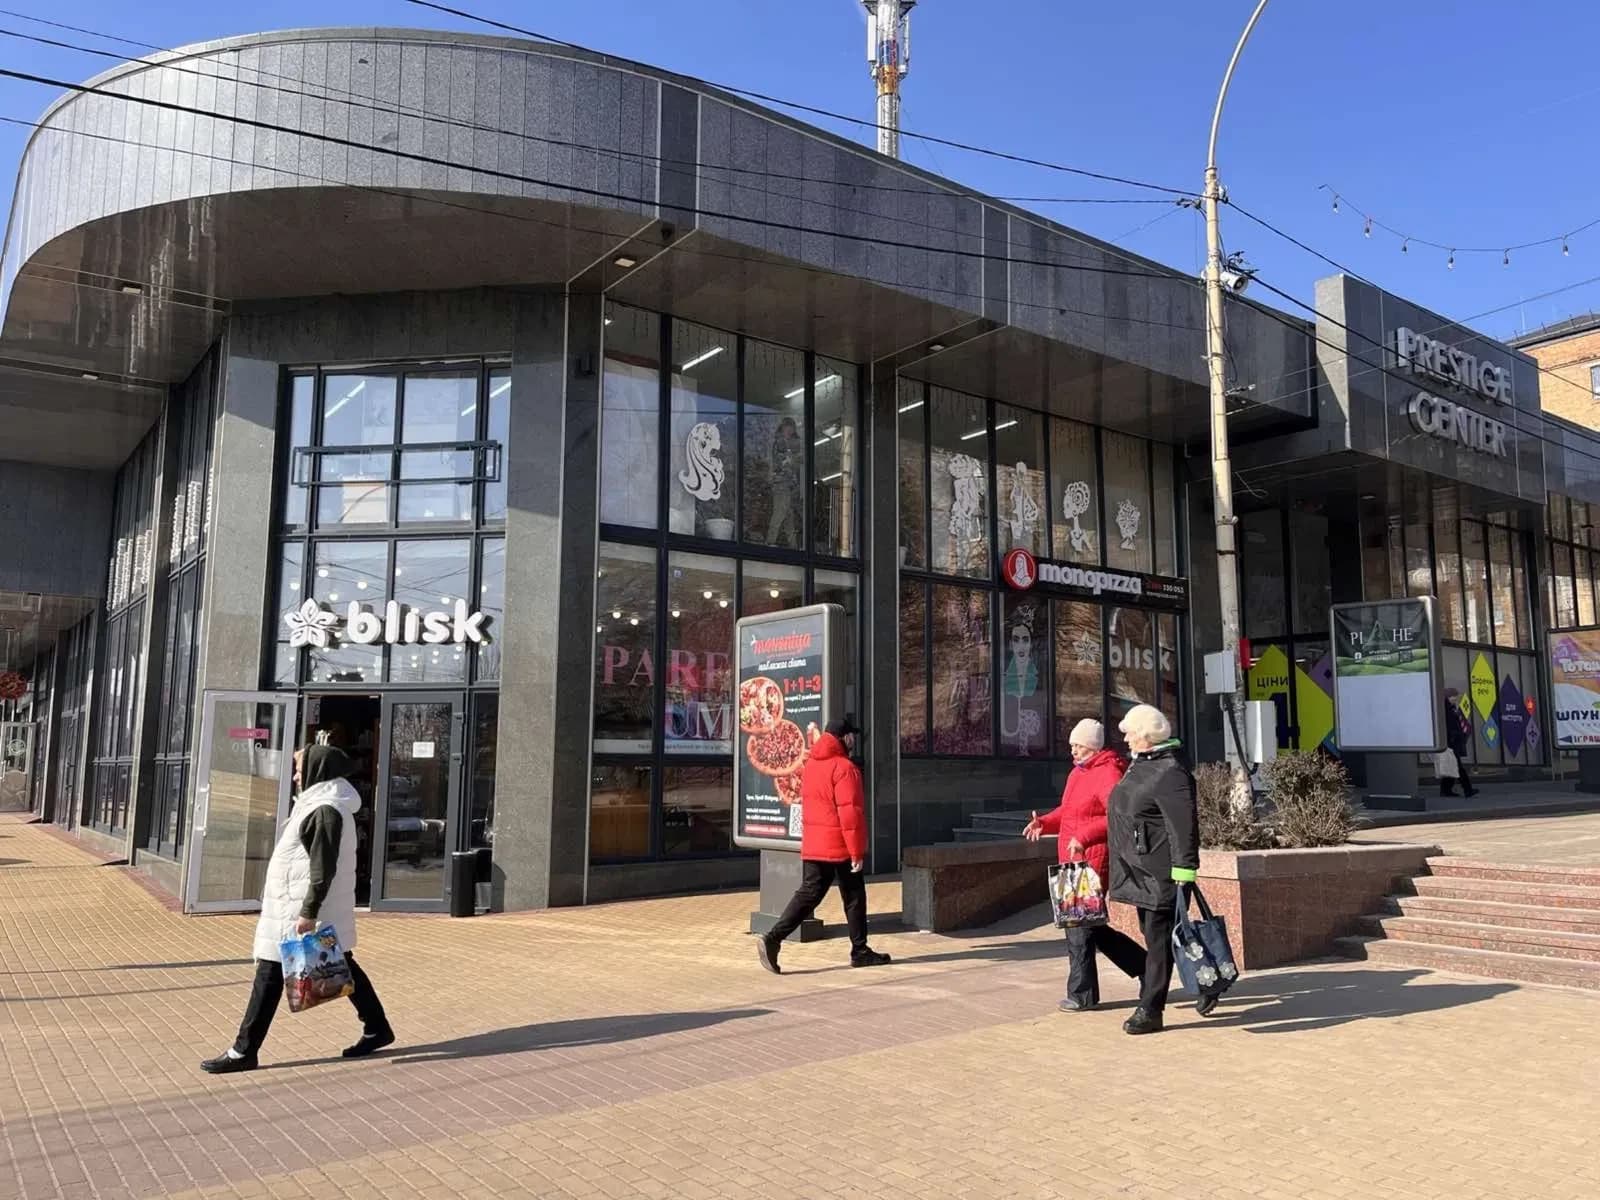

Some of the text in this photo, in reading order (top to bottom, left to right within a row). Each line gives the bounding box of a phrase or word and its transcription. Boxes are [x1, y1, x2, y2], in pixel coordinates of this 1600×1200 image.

[1396, 326, 1513, 406] PRESTIGE
[1409, 391, 1507, 457] CENTER
[1038, 563, 1142, 595] monopizza
[347, 598, 486, 645] blisk
[600, 644, 730, 690] PARF
[1108, 635, 1171, 671] blisk
[783, 674, 823, 695] 1+1=3
[1257, 676, 1288, 689] ЦІНИ
